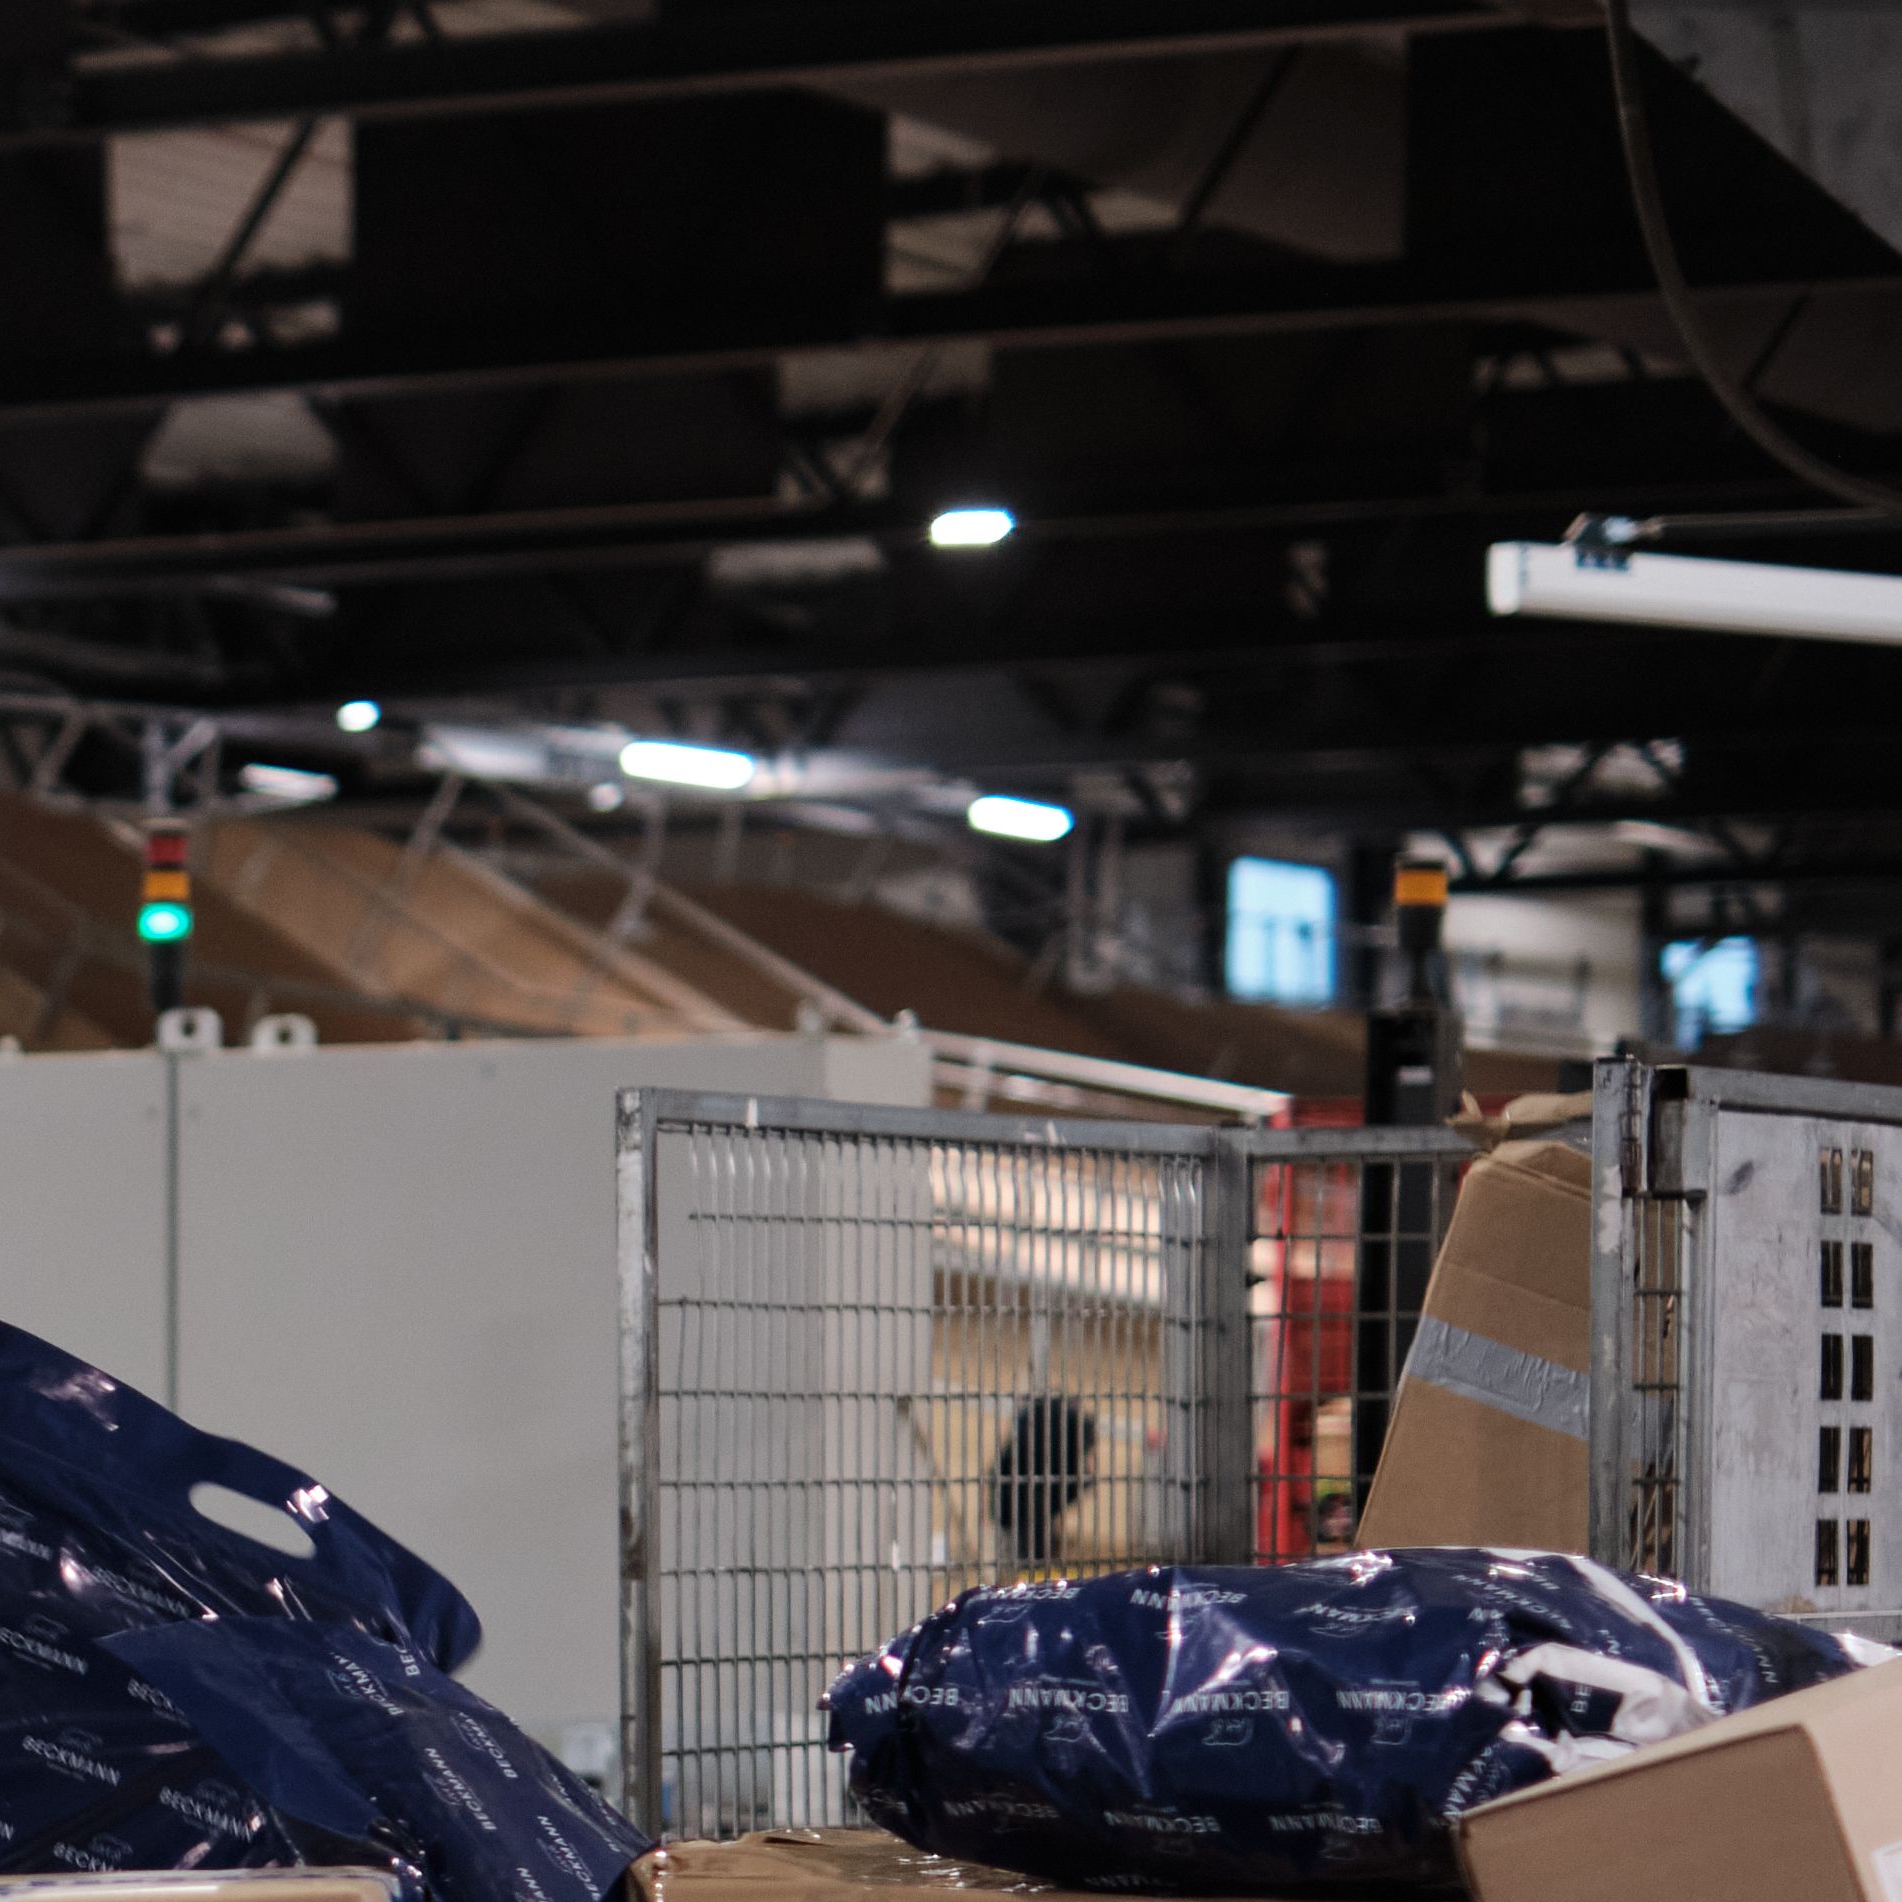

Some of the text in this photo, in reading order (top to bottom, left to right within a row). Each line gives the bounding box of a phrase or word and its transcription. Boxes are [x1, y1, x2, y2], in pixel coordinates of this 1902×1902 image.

[1008, 1687, 1130, 1715] BECKMANN
[22, 1733, 122, 1788] BECKMANN
[425, 1747, 499, 1832] BECKMANN
